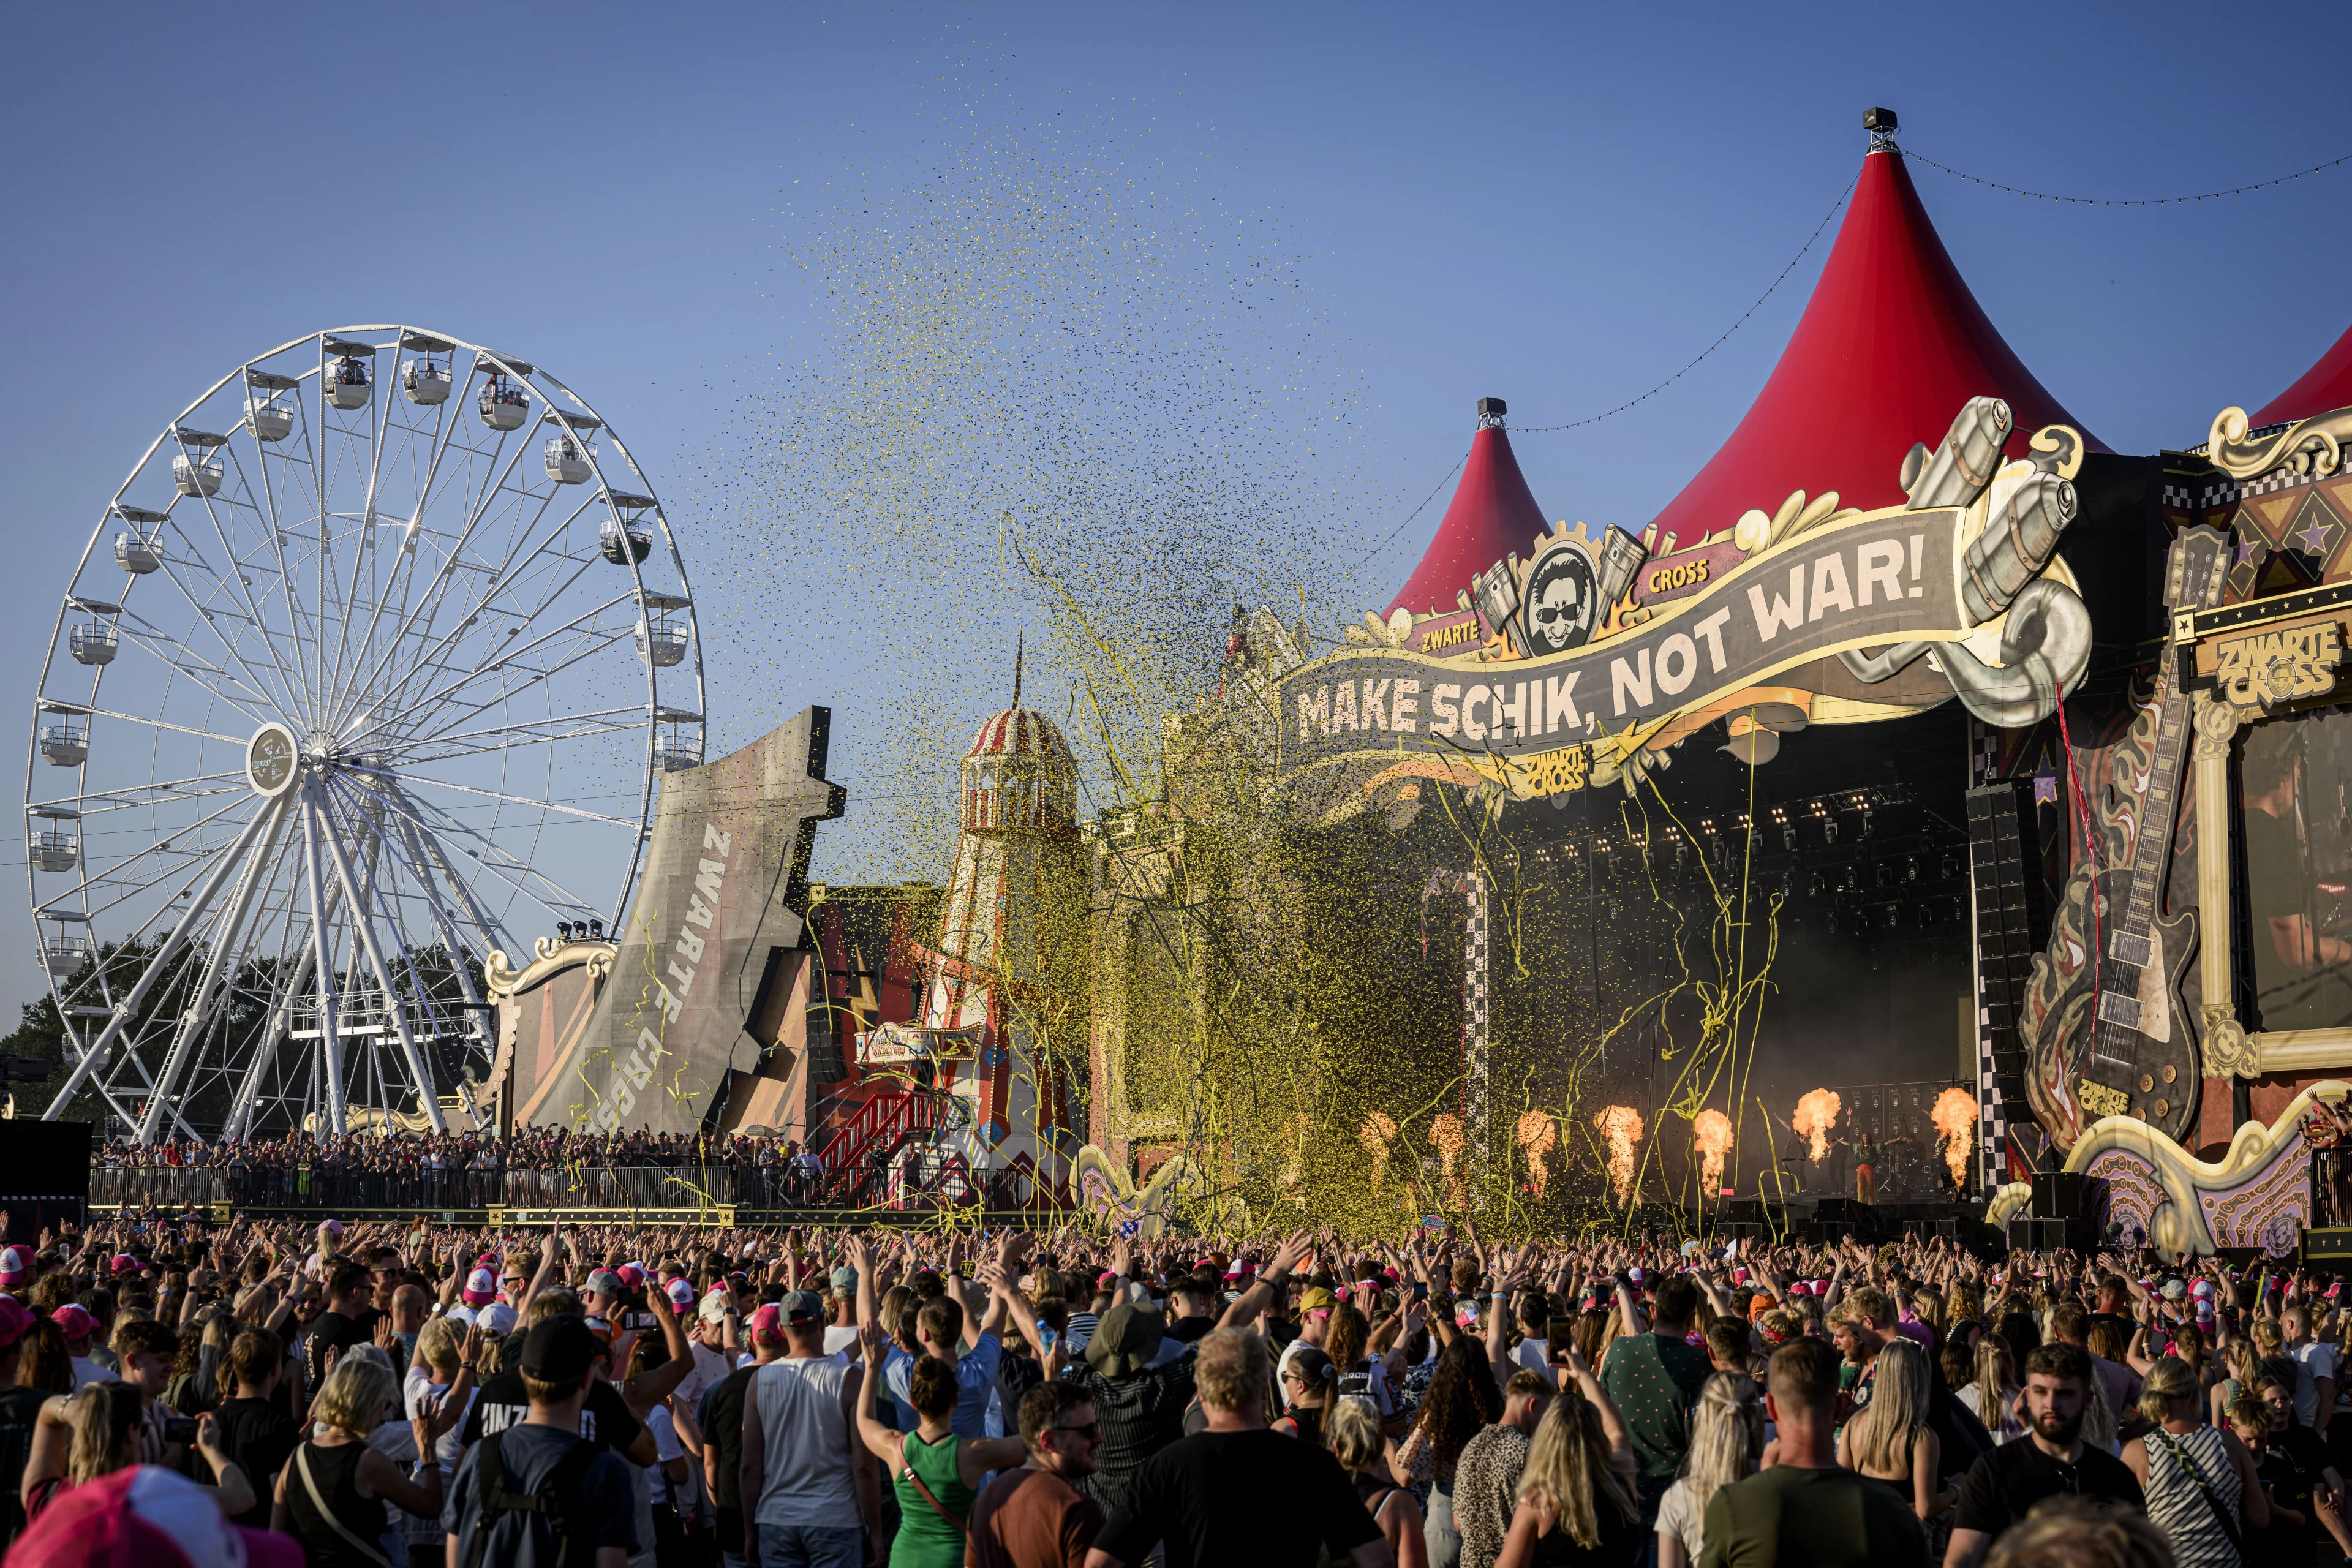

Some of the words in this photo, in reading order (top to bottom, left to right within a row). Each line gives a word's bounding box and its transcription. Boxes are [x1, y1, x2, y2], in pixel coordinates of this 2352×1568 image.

[1298, 678, 1420, 744] MAKE
[1430, 671, 1595, 741] SCHIK,
[1611, 606, 1730, 716] NOT
[1747, 534, 1924, 643] WAR!
[1422, 620, 1478, 652] ZWARTE
[1649, 559, 1709, 593] CROSS
[2219, 622, 2340, 682] ZWARTE
[1527, 745, 1588, 782] ZWARTE
[1531, 768, 1584, 796] CROSS
[655, 823, 732, 1024] ZWARTE
[583, 1027, 662, 1137] CROS
[2079, 1079, 2128, 1112] ZWARTE
